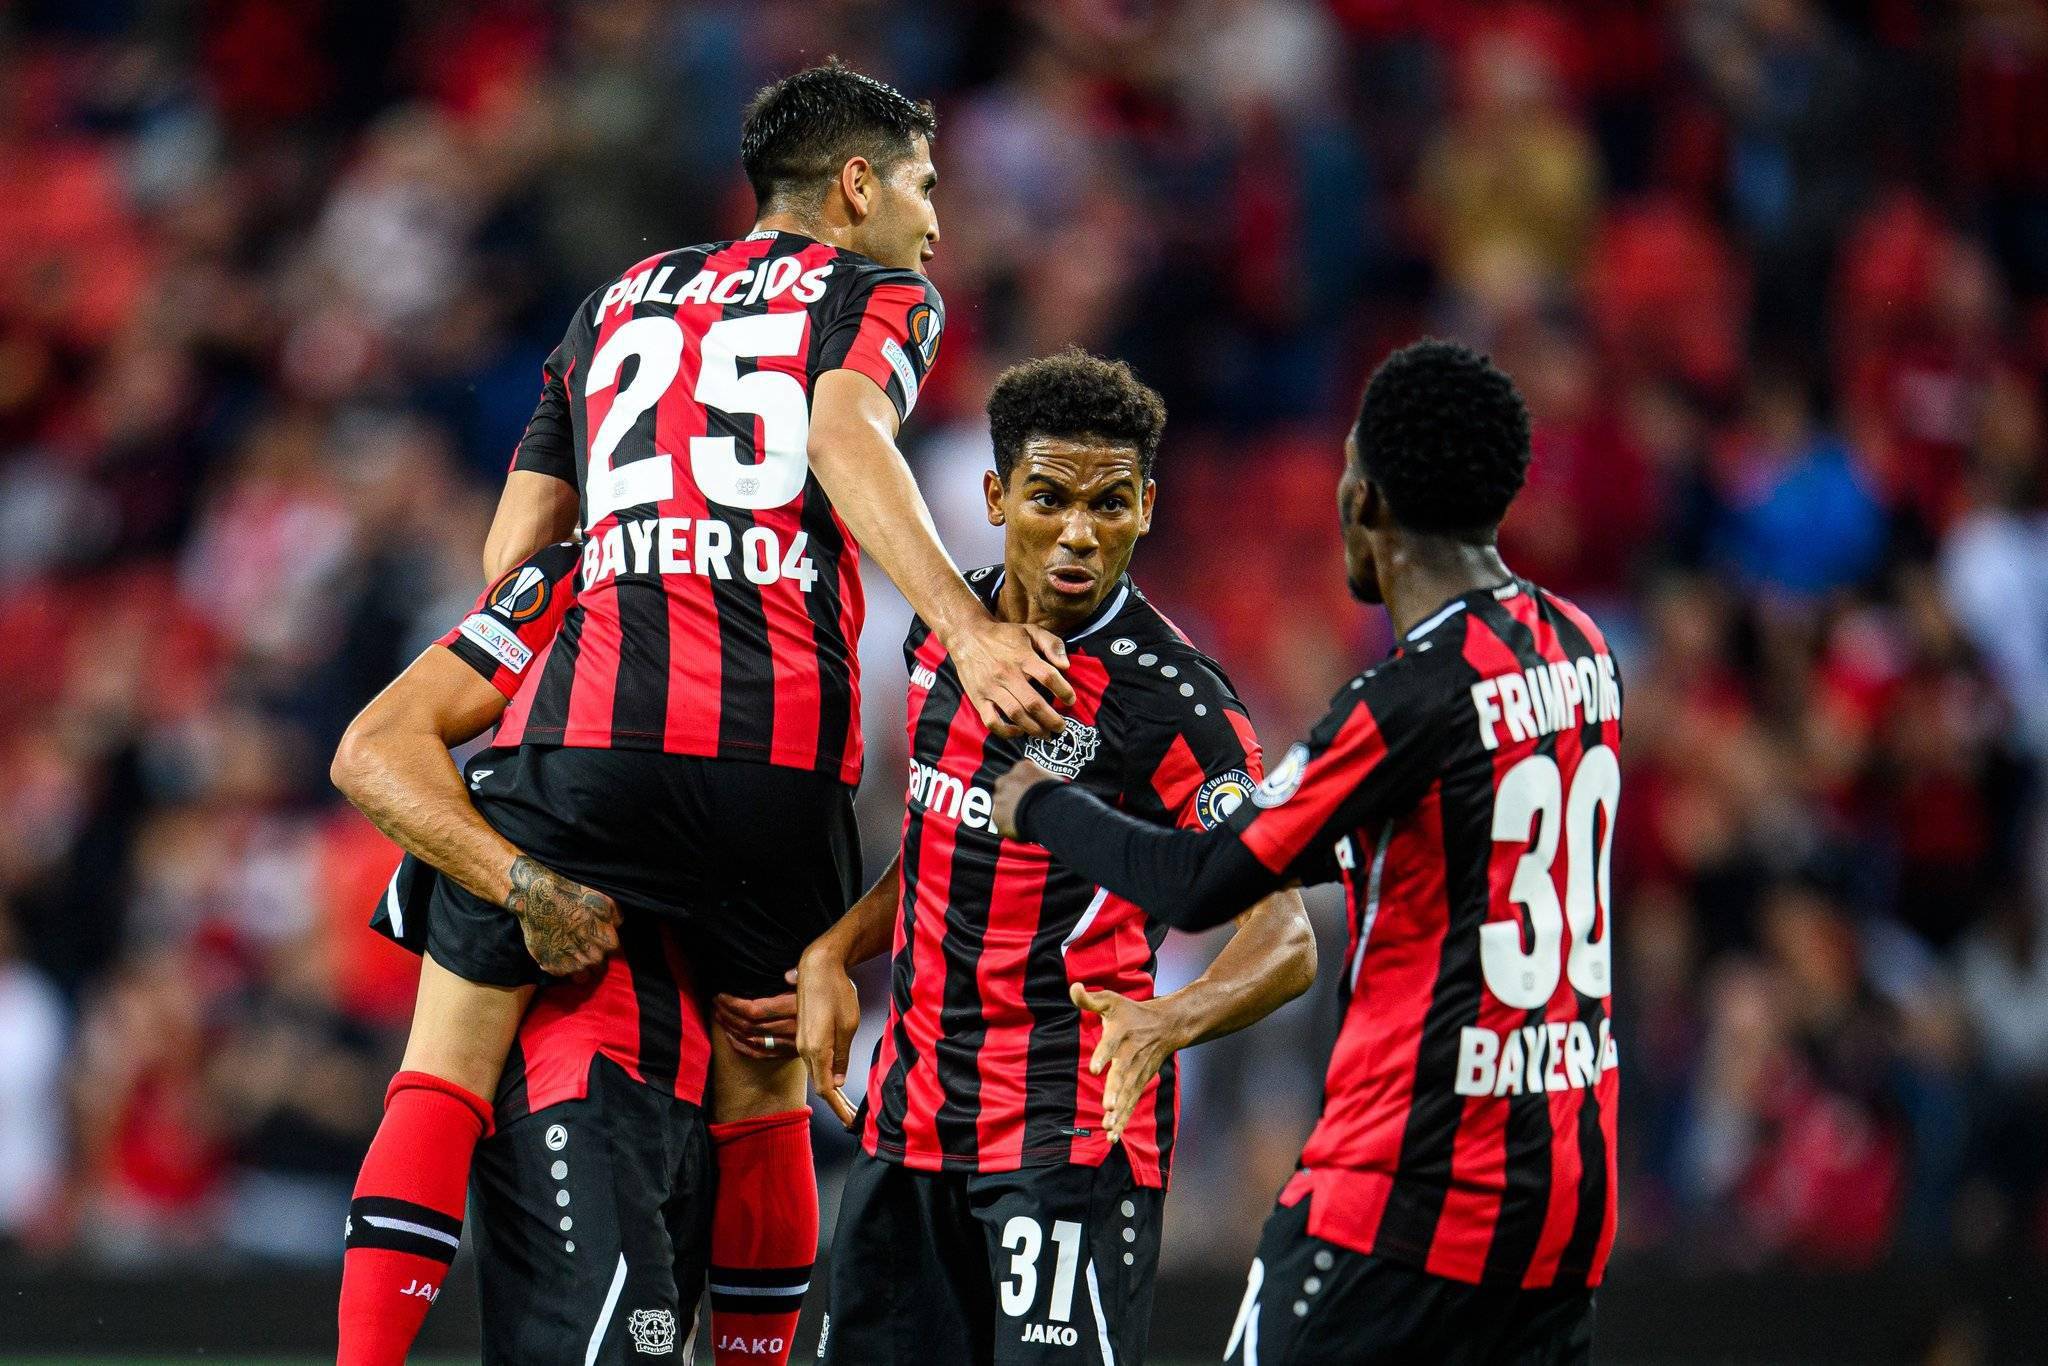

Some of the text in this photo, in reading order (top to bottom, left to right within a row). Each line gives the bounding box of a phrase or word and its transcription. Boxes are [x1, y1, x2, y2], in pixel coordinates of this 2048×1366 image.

[593, 256, 835, 327] PALACIOS
[584, 310, 810, 532] 25
[581, 516, 818, 592] BAYER 04
[910, 664, 937, 690] AKO
[1028, 749, 1073, 775] Leverkusen
[1045, 738, 1074, 754] AYER
[909, 758, 998, 835] arme
[1479, 745, 1621, 1010] 30
[1454, 1020, 1596, 1097] BAYER
[1000, 1216, 1082, 1323] 31
[718, 1335, 784, 1355] JAKO
[1021, 1323, 1078, 1347] JAKO
